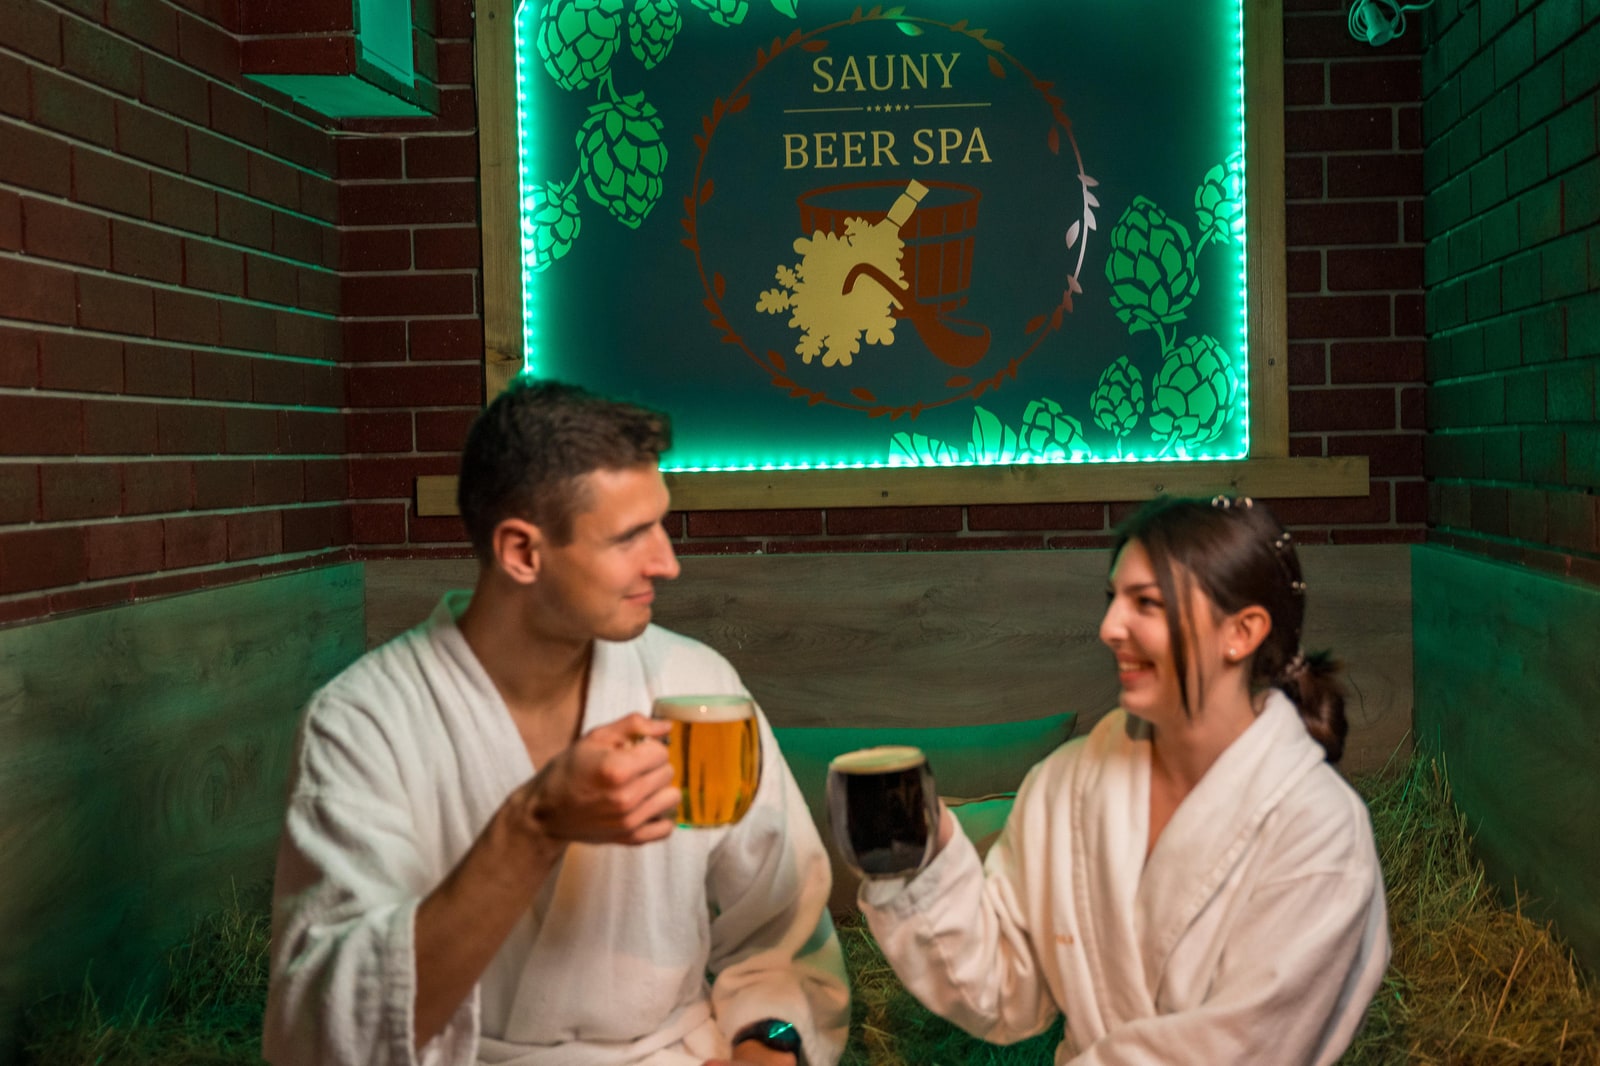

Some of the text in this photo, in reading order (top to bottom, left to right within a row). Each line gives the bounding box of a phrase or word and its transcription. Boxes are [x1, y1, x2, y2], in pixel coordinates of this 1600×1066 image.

[812, 52, 961, 93] SAUNY
[783, 127, 993, 170] BEER SPA
